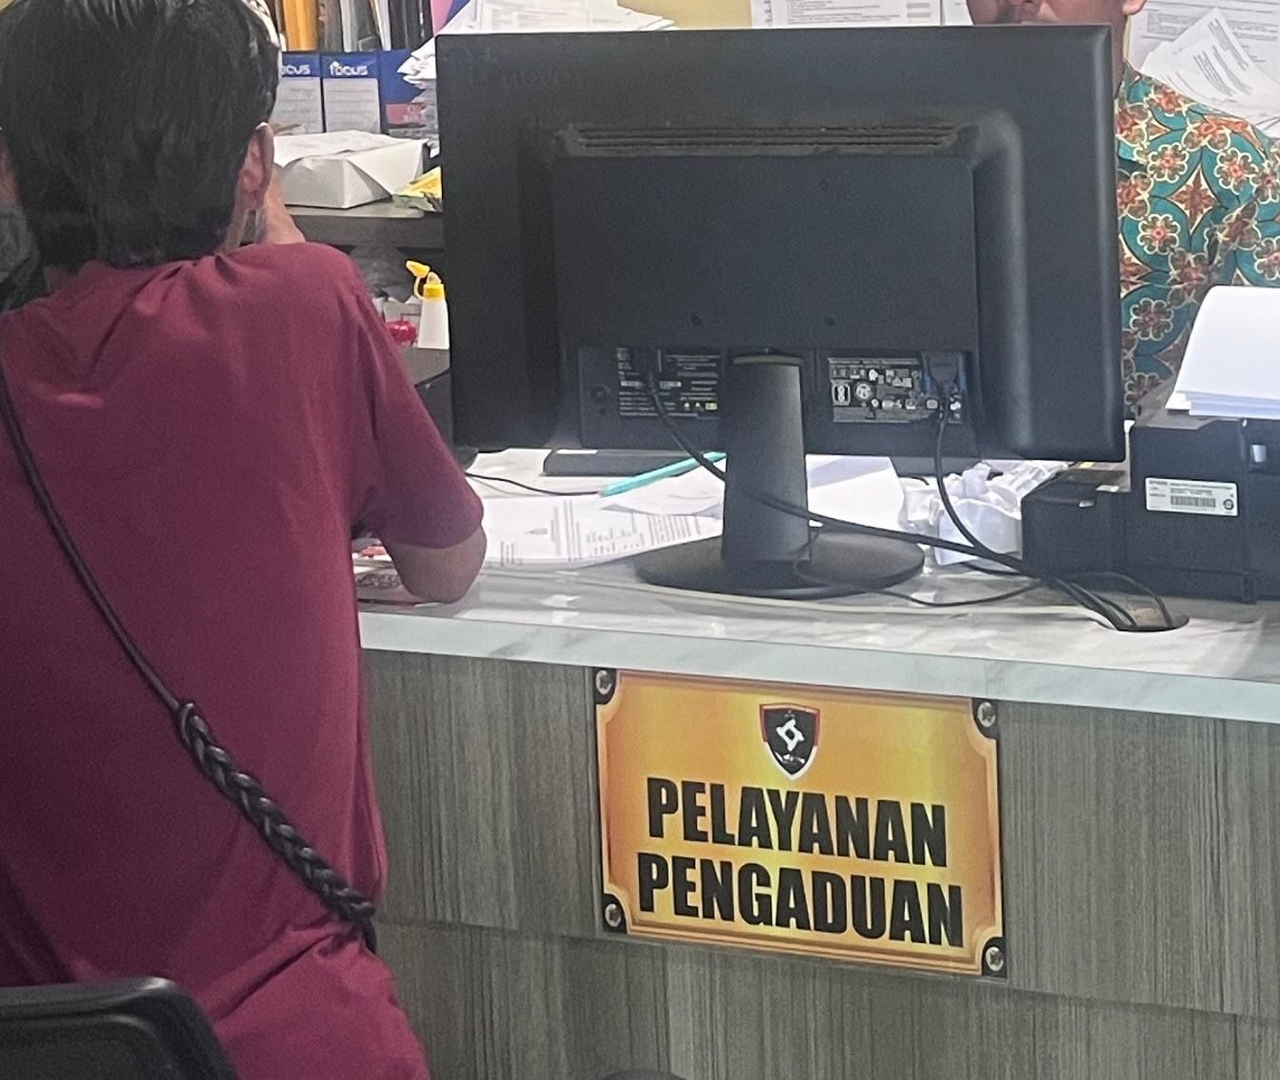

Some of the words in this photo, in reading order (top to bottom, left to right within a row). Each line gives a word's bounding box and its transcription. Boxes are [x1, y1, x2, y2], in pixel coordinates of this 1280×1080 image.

[329, 60, 369, 77] focus
[647, 776, 948, 868] PELAYANAN
[636, 852, 965, 948] PENGADUAN
